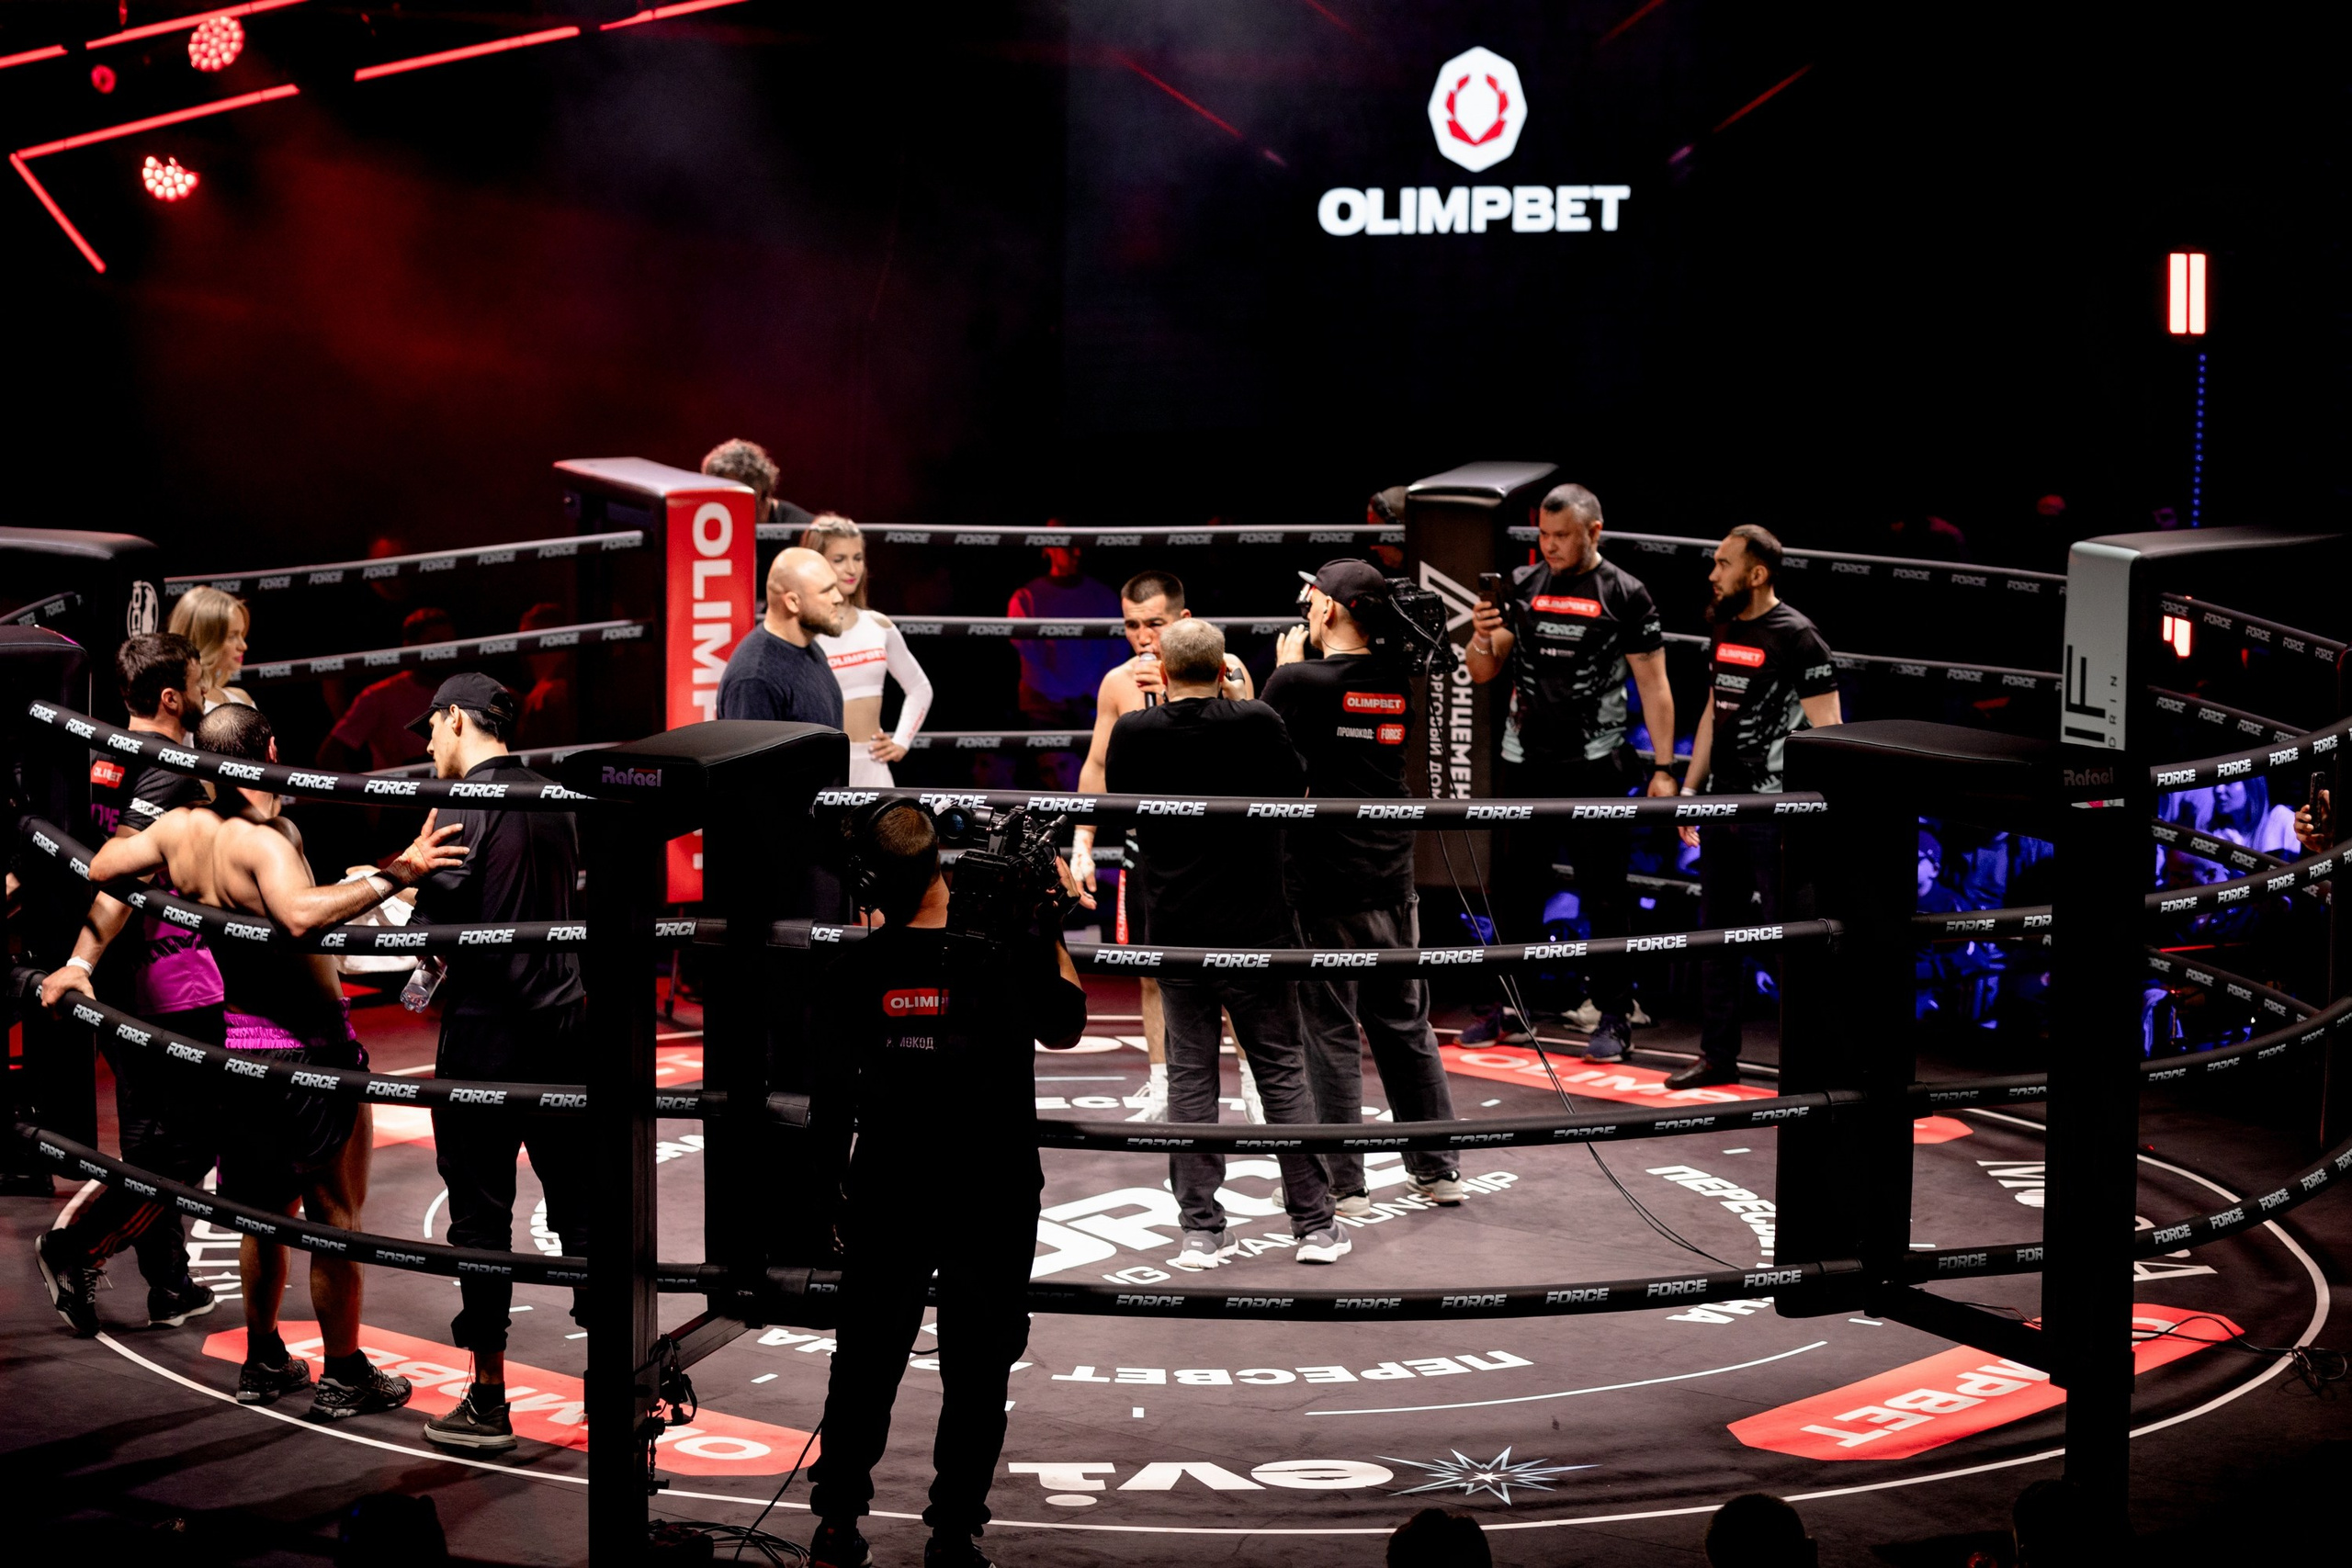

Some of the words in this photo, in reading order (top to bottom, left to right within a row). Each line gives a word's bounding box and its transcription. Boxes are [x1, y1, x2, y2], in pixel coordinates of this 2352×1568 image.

[1317, 185, 1631, 236] OLIMPBET
[1535, 621, 1587, 637] FORCE
[2161, 599, 2189, 616] FORCE
[2204, 612, 2233, 630] FORCE
[2245, 625, 2271, 642] FORCE
[2283, 637, 2305, 653] FORCE
[2315, 647, 2334, 662] FORCE
[1715, 673, 1750, 689] FORCE
[1347, 696, 1401, 709] OLIMPBET
[1429, 673, 1444, 756] ОРГОВЫЙ
[2156, 695, 2187, 714] FORCE
[2199, 707, 2227, 725] FORCE
[2237, 719, 2264, 737] FORCE
[28, 703, 57, 724] FORCE
[65, 718, 96, 739] FORCE
[107, 733, 142, 754] FORCE
[157, 748, 199, 769] FORCE
[218, 761, 265, 781] FORCE
[287, 773, 338, 790] FORCE
[364, 780, 421, 796] FORCE
[448, 784, 509, 798] FORCE
[1381, 728, 1403, 740] FORCE
[602, 766, 662, 787] Rafael
[2064, 767, 2114, 787] Rafael
[2156, 769, 2196, 786] FORCE
[2218, 759, 2251, 776] FORCE
[2269, 747, 2298, 766] FORCE
[2312, 735, 2337, 754] FORCE
[814, 792, 878, 806] FORCE
[1026, 796, 1096, 812] FORCE
[1137, 800, 1206, 816] FORCE
[1247, 803, 1317, 818] FORCE
[1357, 806, 1426, 819] FORCE
[1465, 806, 1533, 819] FORCE
[1571, 804, 1638, 818] FORCE
[1675, 804, 1737, 818] FORCE
[32, 831, 59, 857] FORCE
[2151, 825, 2178, 842] FORCE
[2190, 837, 2220, 855] FORCE
[2231, 851, 2256, 869] FORCE
[2161, 896, 2197, 912] FORCE
[2218, 886, 2249, 903] FORCE
[2267, 874, 2294, 892] FORCE
[2309, 860, 2332, 878] FORCE
[163, 906, 202, 929] FORCE
[224, 922, 271, 942] FORCE
[375, 932, 428, 948] FORCE
[458, 929, 515, 945] FORCE
[547, 927, 586, 942] FOR
[656, 922, 695, 937] ORC
[1946, 919, 1995, 932] FORCE
[2023, 915, 2052, 928] FOR
[1093, 950, 1162, 965] FORCE
[1203, 953, 1271, 968] FORCE
[1310, 953, 1378, 967] FORCE
[1419, 949, 1484, 964] FORCE
[1523, 943, 1587, 960] FORCE
[1626, 935, 1687, 953] FORCE
[1724, 926, 1782, 943] FORCE
[72, 1004, 103, 1026] FORCE
[116, 1023, 151, 1046] FORCE
[165, 1042, 206, 1063] FORCE
[224, 1058, 268, 1078] FORCE
[291, 1071, 340, 1089] FORCE
[367, 1080, 420, 1100] FORCE
[449, 1089, 507, 1105] FORCE
[539, 1093, 586, 1109] FORC
[40, 1142, 65, 1160] FORCE
[79, 1159, 107, 1179] FORCE
[124, 1178, 157, 1198] FORCE
[175, 1196, 213, 1216] FORCE
[2153, 1224, 2191, 1245] FORCE
[2210, 1207, 2245, 1231] FORCE
[2258, 1188, 2290, 1213] FORCE
[2300, 1167, 2327, 1191] FORCE
[1938, 1254, 1986, 1269] FORCE
[2016, 1247, 2043, 1263] FOR
[1334, 1298, 1401, 1311] FORCE
[1441, 1293, 1507, 1309] FORCE
[1545, 1288, 1610, 1304] FORCE
[1646, 1279, 1707, 1297] FORCE
[1744, 1269, 1802, 1287] FORCE
[1052, 1350, 1535, 1385] ПЕРЕСВЕТ
